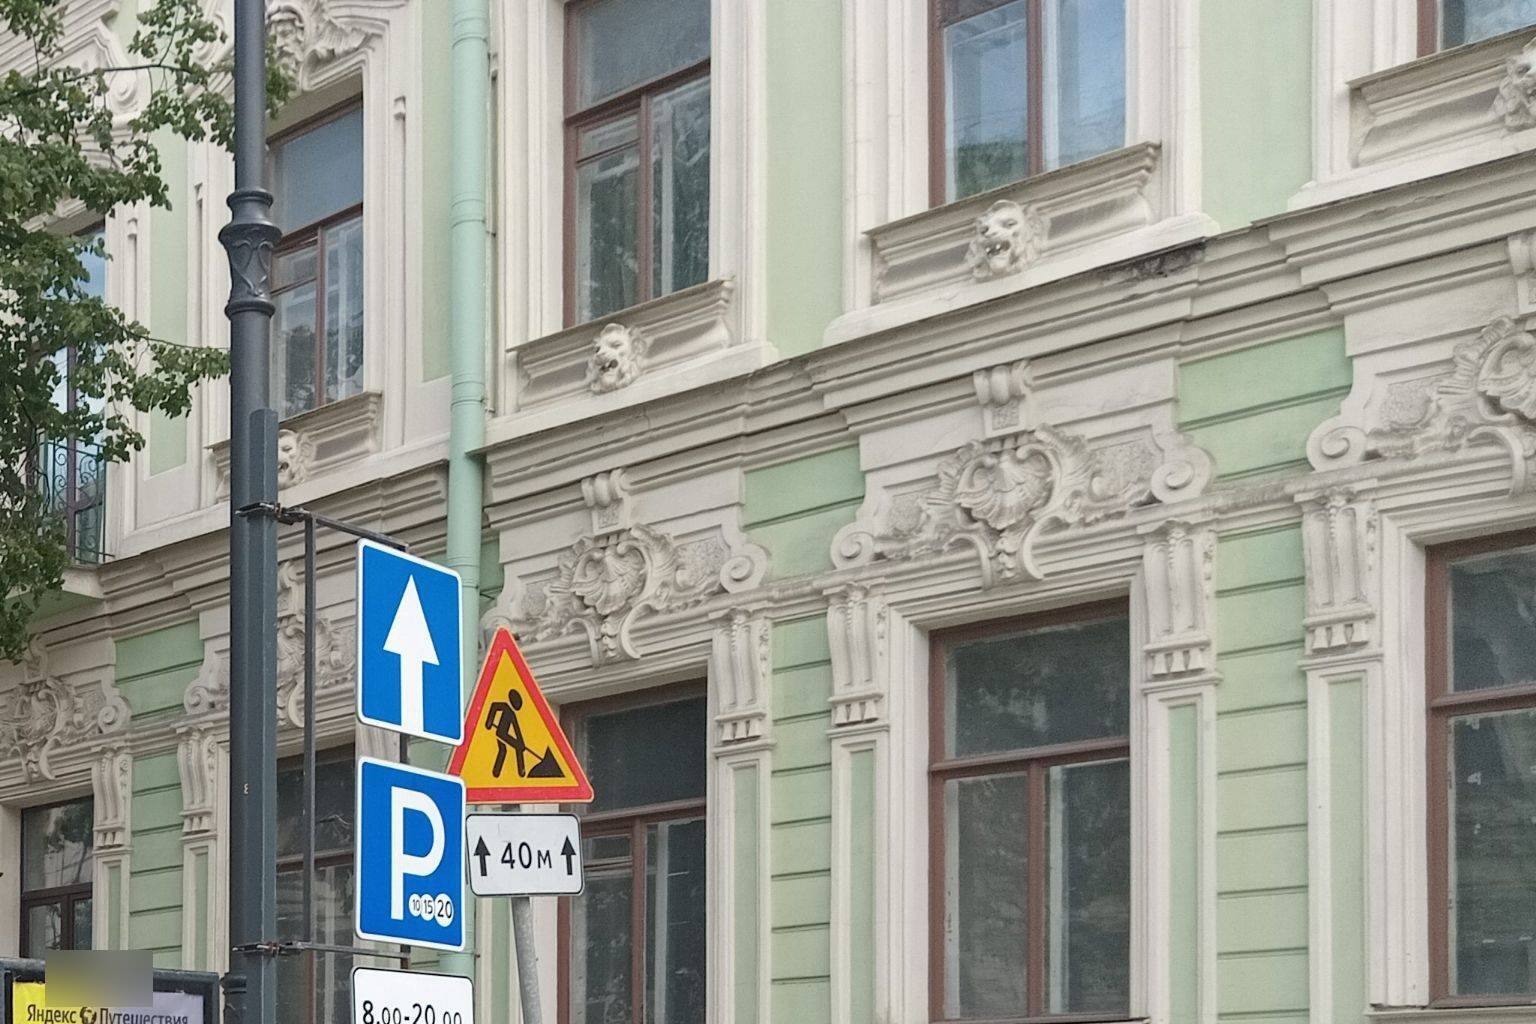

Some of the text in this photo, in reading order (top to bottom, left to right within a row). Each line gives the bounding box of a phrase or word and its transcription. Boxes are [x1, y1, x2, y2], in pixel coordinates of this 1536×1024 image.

[390, 785, 446, 921] P
[411, 898, 453, 920] 10 15 20
[27, 1004, 77, 1024] Яндекс
